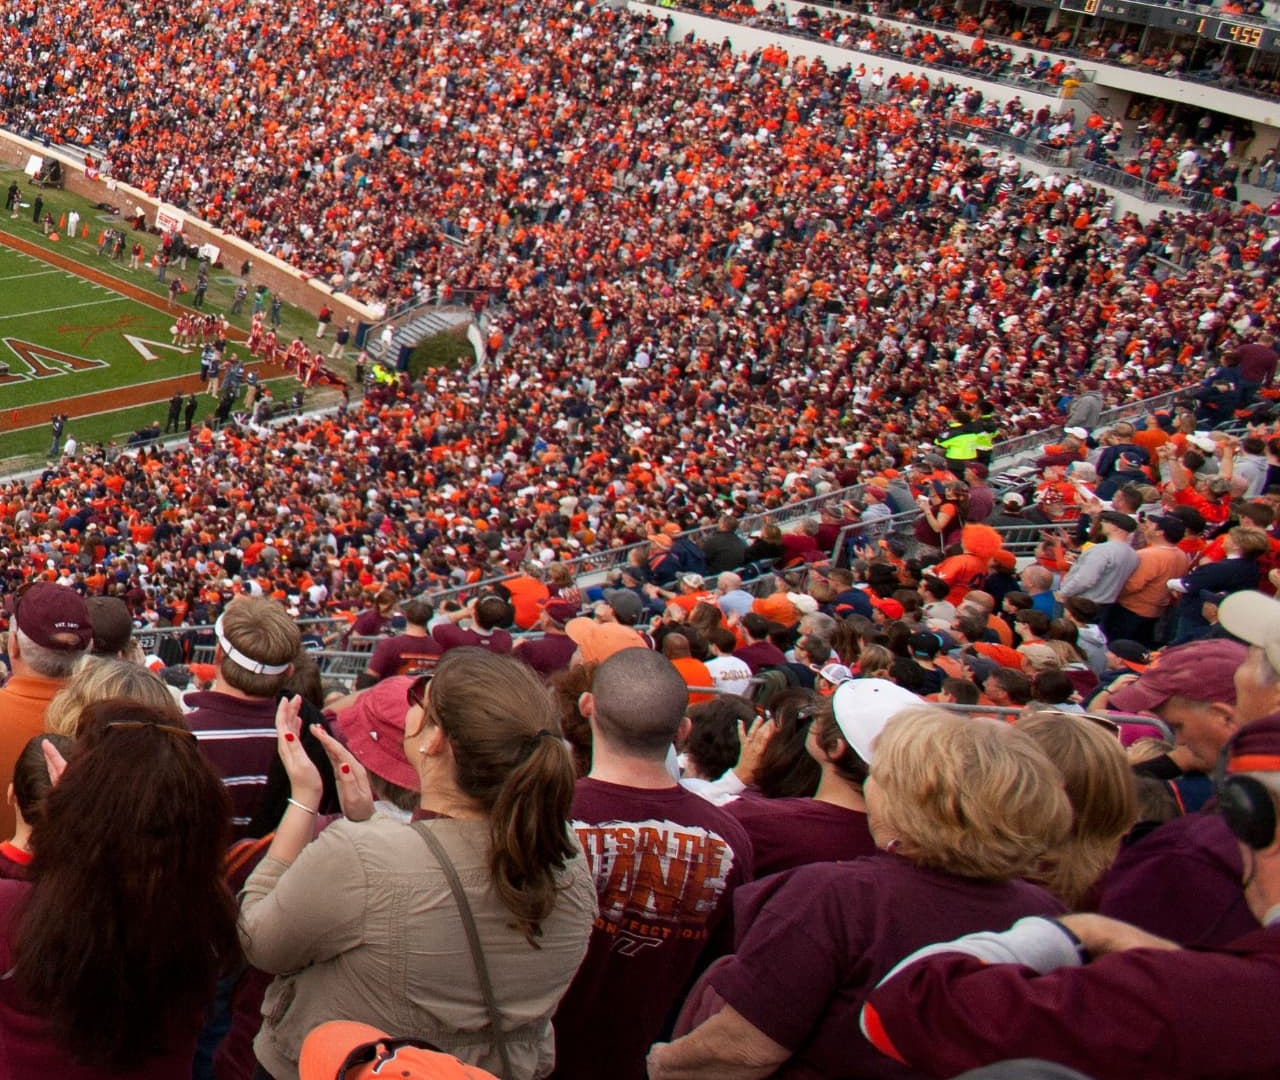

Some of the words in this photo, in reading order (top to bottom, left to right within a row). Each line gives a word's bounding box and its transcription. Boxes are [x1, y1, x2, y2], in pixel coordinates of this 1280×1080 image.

[1197, 19, 1206, 33] 1
[576, 828, 635, 857] IT'S
[636, 827, 669, 858] IN
[674, 832, 727, 867] THE
[590, 852, 724, 923] ANE
